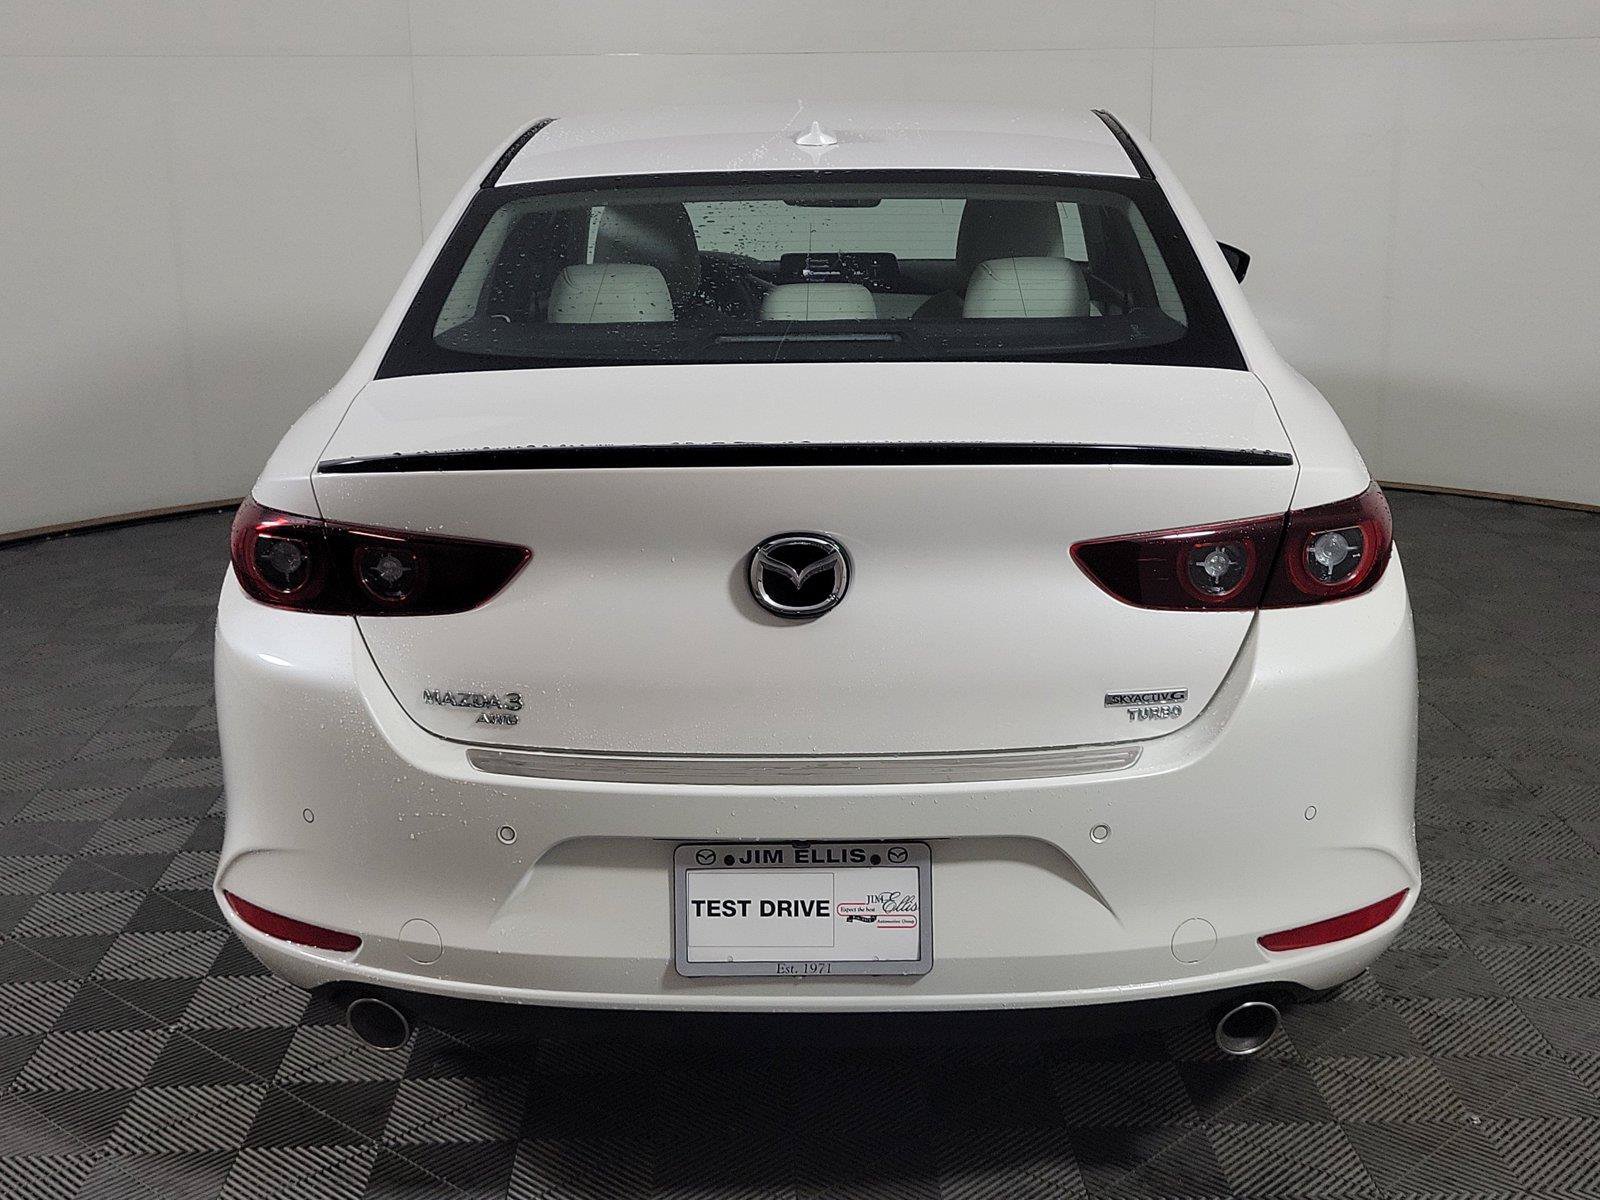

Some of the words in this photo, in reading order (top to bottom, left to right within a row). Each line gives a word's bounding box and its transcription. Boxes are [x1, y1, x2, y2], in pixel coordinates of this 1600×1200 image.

[475, 713, 519, 725] AWD
[1127, 705, 1182, 722] TURBO
[739, 849, 784, 864] JIM
[794, 848, 866, 864] ELLIS
[691, 899, 752, 917] TEST
[759, 899, 830, 917] DRIVE
[866, 894, 884, 905] JIM
[880, 891, 918, 914] Ellis
[776, 963, 798, 974] Est.
[803, 963, 832, 974] 1971
